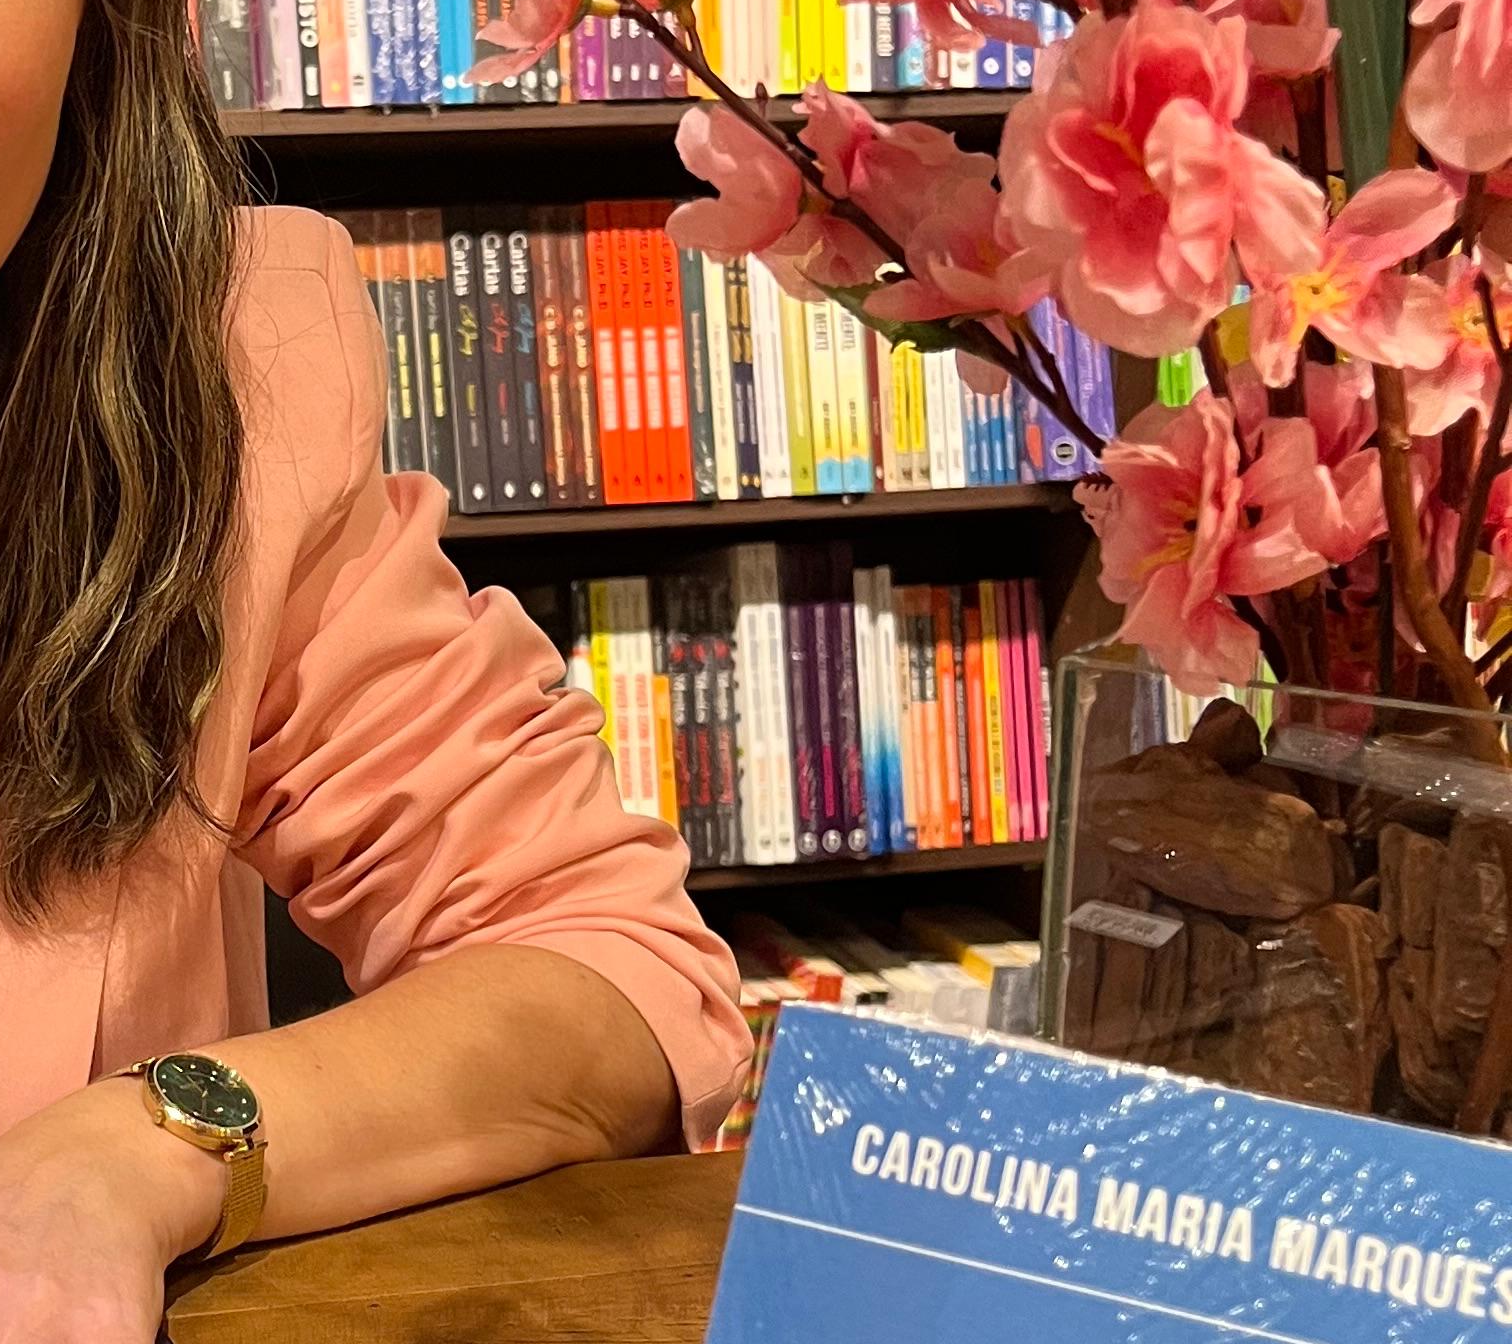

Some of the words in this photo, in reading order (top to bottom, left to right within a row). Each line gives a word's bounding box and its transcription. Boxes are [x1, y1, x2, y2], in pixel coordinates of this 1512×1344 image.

[449, 231, 470, 296] Cartas
[481, 231, 501, 295] Cartas
[509, 231, 528, 295] Cartas
[851, 1123, 1080, 1221] CAROLINA
[1092, 1179, 1254, 1262] MARIA
[1269, 1217, 1512, 1327] MARQUES
